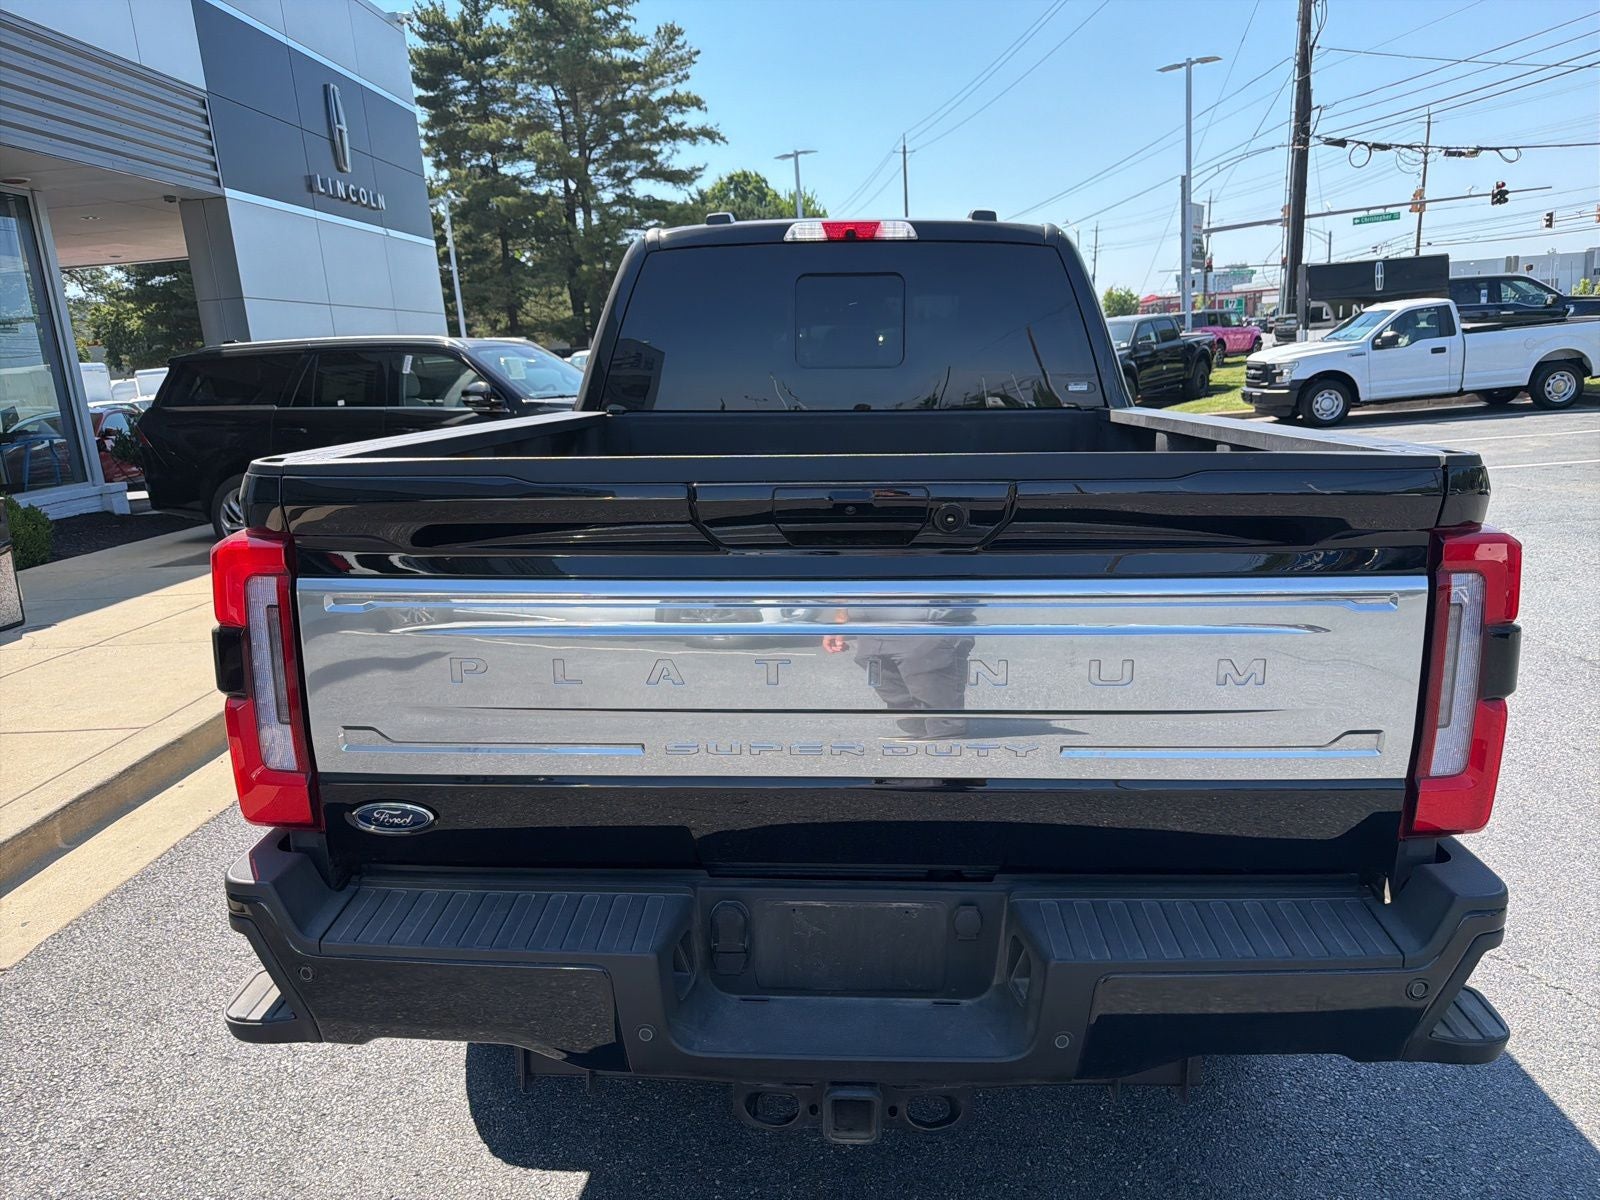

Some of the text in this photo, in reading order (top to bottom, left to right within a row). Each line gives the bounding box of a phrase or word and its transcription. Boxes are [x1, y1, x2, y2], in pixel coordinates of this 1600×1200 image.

[315, 174, 386, 210] LINCOLN
[449, 657, 1267, 686] PLATINUM
[665, 741, 1040, 757] SUPER DUTY
[371, 809, 414, 826] Ford
